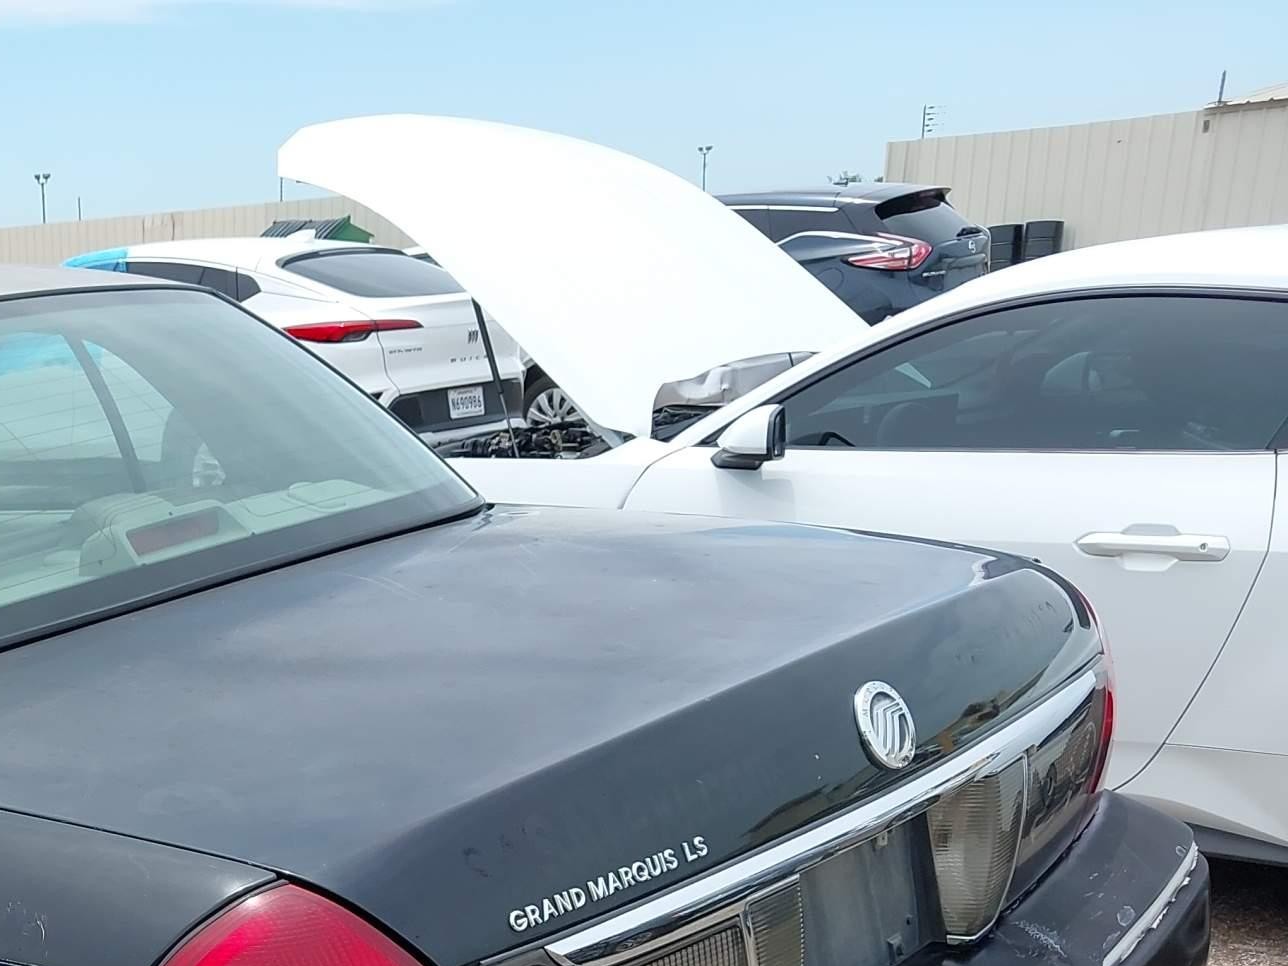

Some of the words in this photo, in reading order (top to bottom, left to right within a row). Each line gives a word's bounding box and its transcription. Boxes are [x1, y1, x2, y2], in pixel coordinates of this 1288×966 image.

[509, 887, 586, 932] GRAND
[586, 848, 679, 902] MARQUIS
[681, 836, 708, 862] LS
